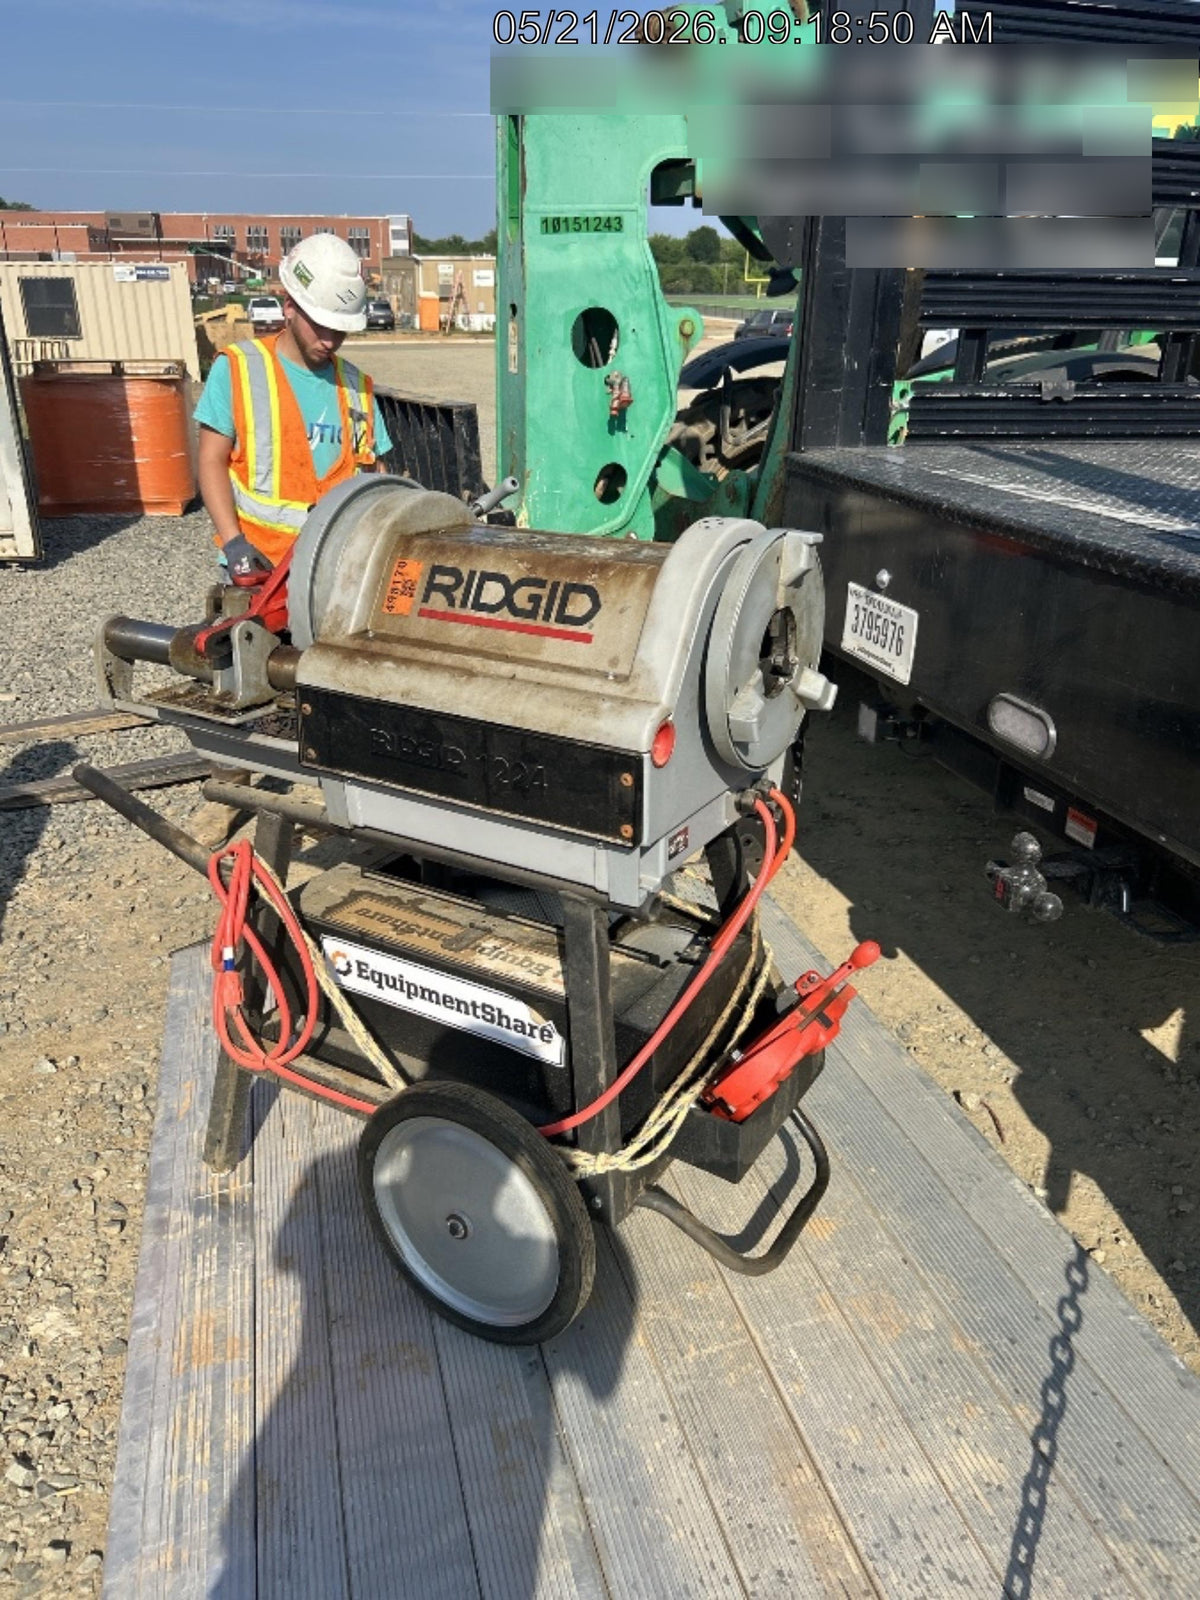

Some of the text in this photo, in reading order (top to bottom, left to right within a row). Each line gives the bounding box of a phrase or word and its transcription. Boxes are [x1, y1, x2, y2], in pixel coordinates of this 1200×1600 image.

[540, 216, 624, 234] 10151243
[421, 564, 602, 626] RIDGID
[355, 958, 555, 1045] EquipmentShare
